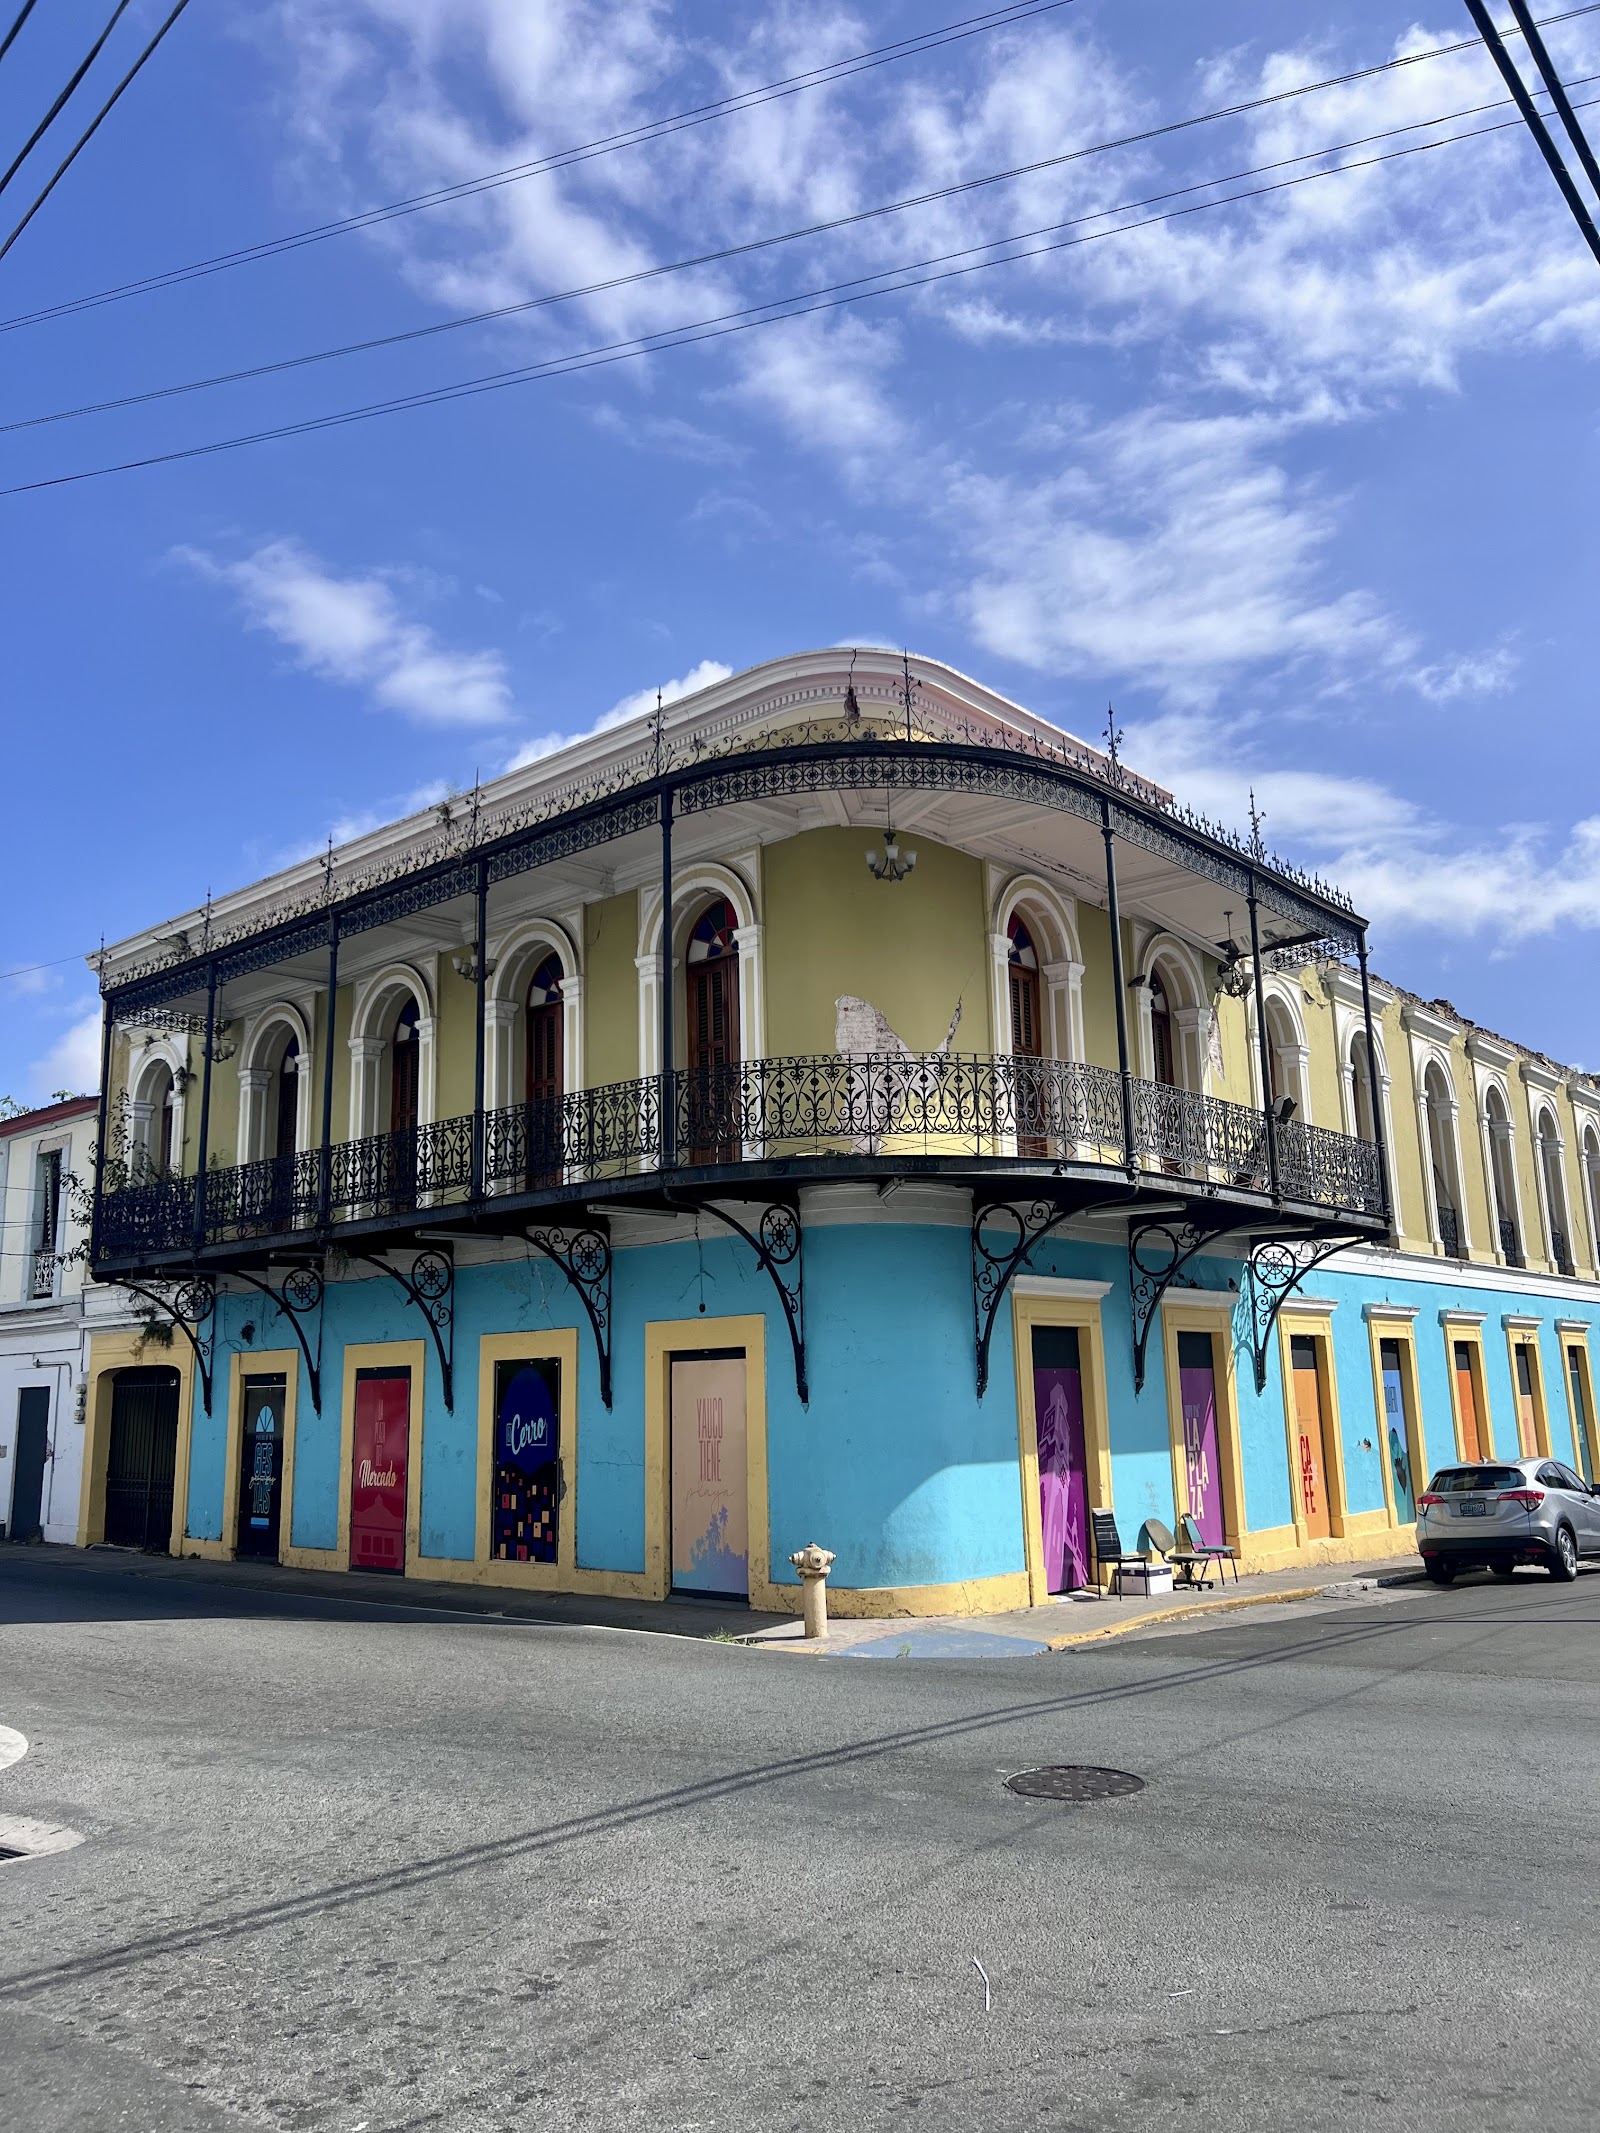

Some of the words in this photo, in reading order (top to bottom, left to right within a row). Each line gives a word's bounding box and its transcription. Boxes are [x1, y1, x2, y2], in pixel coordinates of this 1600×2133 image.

[511, 1413, 546, 1455] Cerro
[697, 1397, 723, 1439] YAUCO
[1186, 1418, 1200, 1452] LA
[359, 1459, 398, 1489] Mercado
[699, 1440, 721, 1482] TIENE
[1188, 1450, 1210, 1486] PLA
[684, 1481, 735, 1515] playa
[1190, 1485, 1205, 1521] ZA
